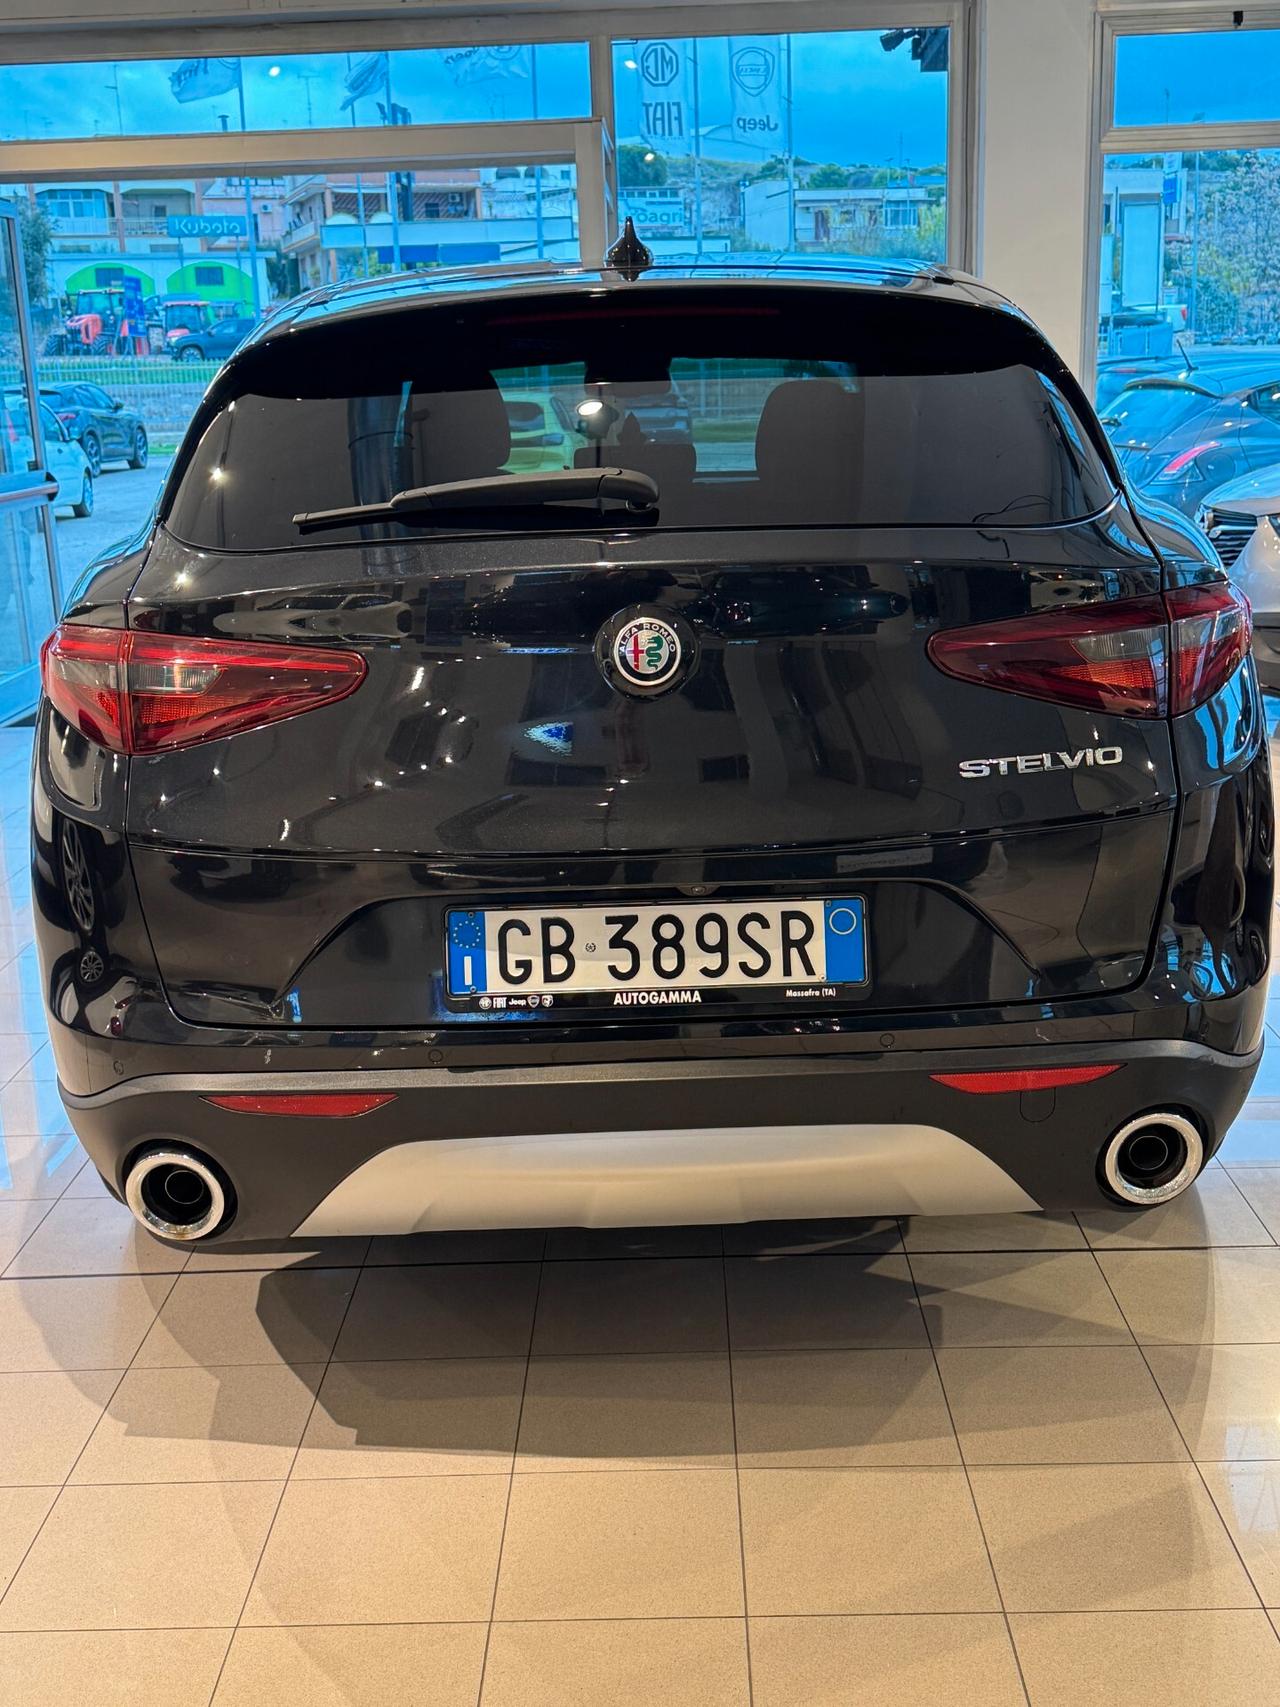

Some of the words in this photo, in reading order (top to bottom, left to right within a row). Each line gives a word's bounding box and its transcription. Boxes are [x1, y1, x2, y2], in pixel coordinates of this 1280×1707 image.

[175, 218, 241, 235] Kubota
[619, 625, 639, 653] ALFA
[642, 623, 676, 652] ROMEO
[959, 746, 1123, 778] STELVIO
[497, 916, 576, 985] GB
[604, 910, 817, 982] 389SR
[613, 990, 702, 1005] AUTOGAMMA
[785, 988, 820, 998] Massafra
[821, 987, 836, 998] (TA)
[492, 997, 508, 1009] FIAT
[508, 998, 527, 1007] Jeep
